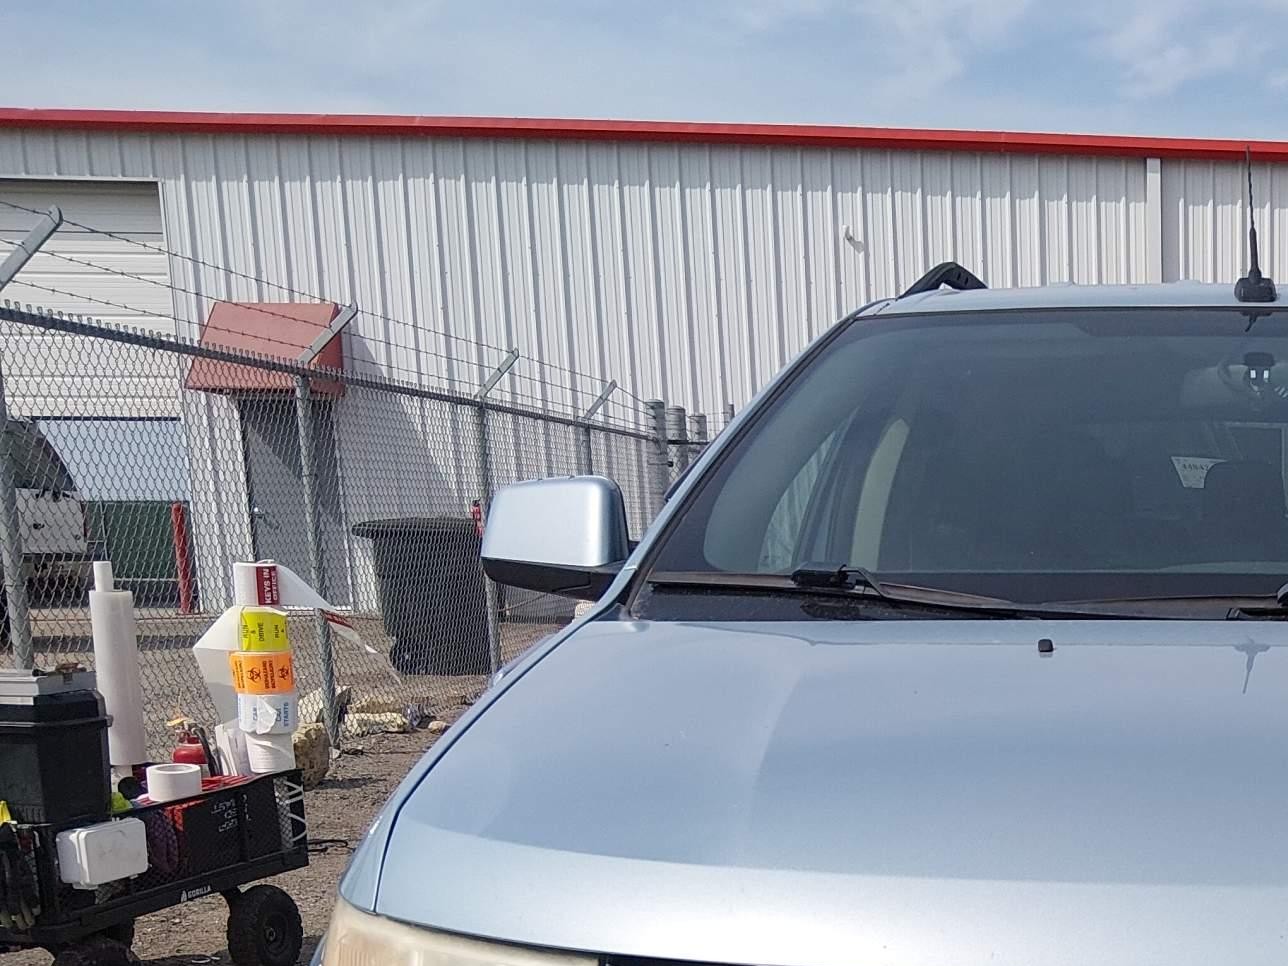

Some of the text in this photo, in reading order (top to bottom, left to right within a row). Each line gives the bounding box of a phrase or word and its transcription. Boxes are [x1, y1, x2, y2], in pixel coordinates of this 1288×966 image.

[263, 567, 273, 604] KEYS IN
[257, 622, 265, 642] DRIVE
